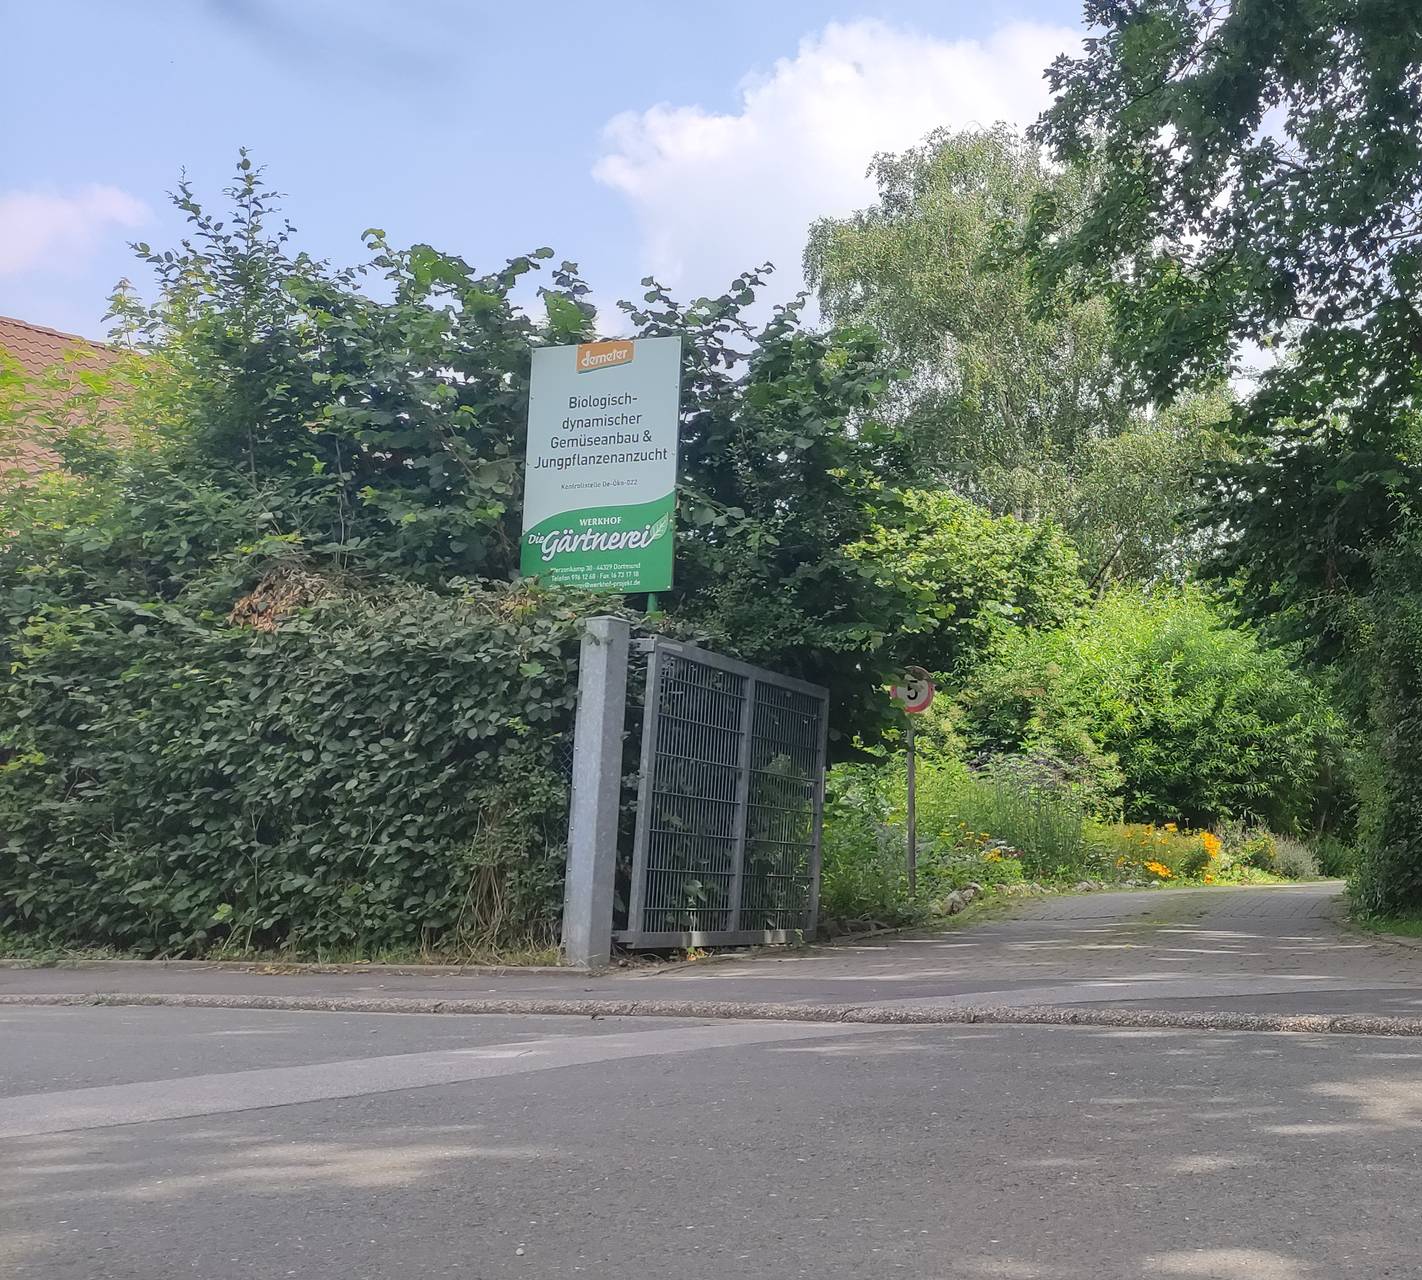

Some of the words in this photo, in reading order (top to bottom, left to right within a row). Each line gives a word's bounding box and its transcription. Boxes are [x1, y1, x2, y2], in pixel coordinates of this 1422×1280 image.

[581, 349, 628, 367] demeter
[569, 392, 638, 410] Biologisch-
[562, 413, 643, 432] dynamischer
[550, 431, 639, 449] Gemüseanbau
[642, 430, 652, 443] &
[534, 448, 668, 471] Jungpflanzenanzucht
[579, 516, 622, 526] WERKHOF
[528, 532, 544, 545] Die
[541, 524, 651, 562] Gärtnerei
[907, 680, 918, 700] 5
